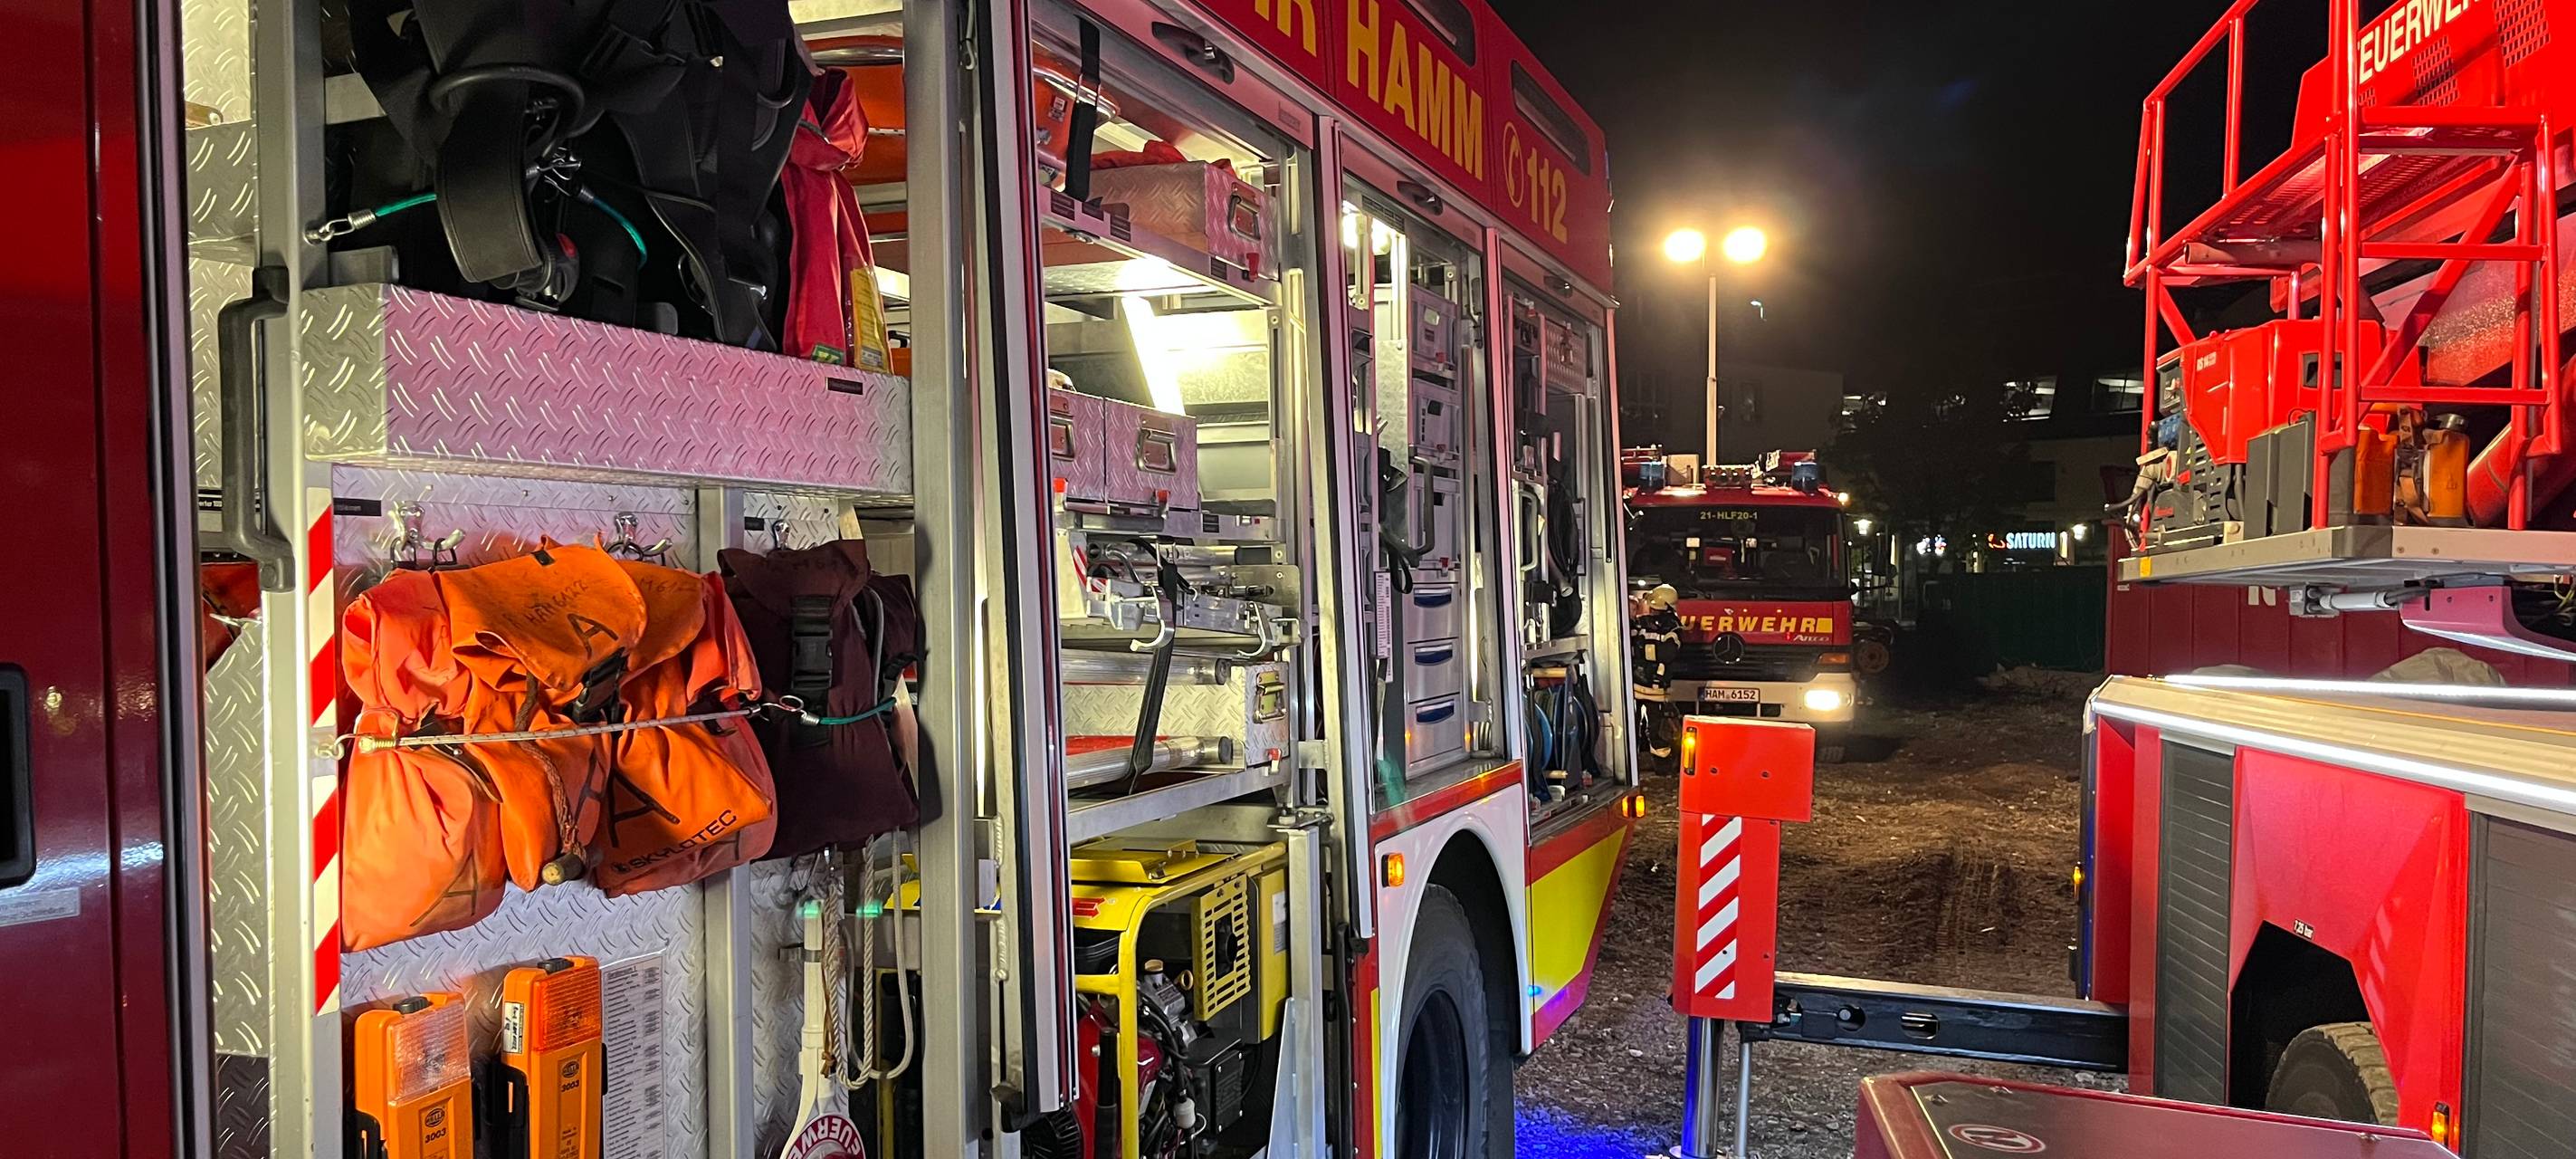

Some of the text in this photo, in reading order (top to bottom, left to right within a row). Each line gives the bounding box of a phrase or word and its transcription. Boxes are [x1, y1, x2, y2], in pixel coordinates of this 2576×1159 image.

[1347, 0, 1483, 181] HAMM
[1527, 148, 1568, 244] 112
[1700, 511, 1758, 520] 21-HLF20-1
[2006, 532, 2056, 550] SATURN
[567, 612, 619, 660] A
[1682, 616, 1817, 633] UERWEHR
[1705, 690, 1756, 700] HAM 6152
[628, 809, 737, 868] SKYLOTEC
[409, 848, 478, 927] A
[425, 1127, 446, 1144] 3003
